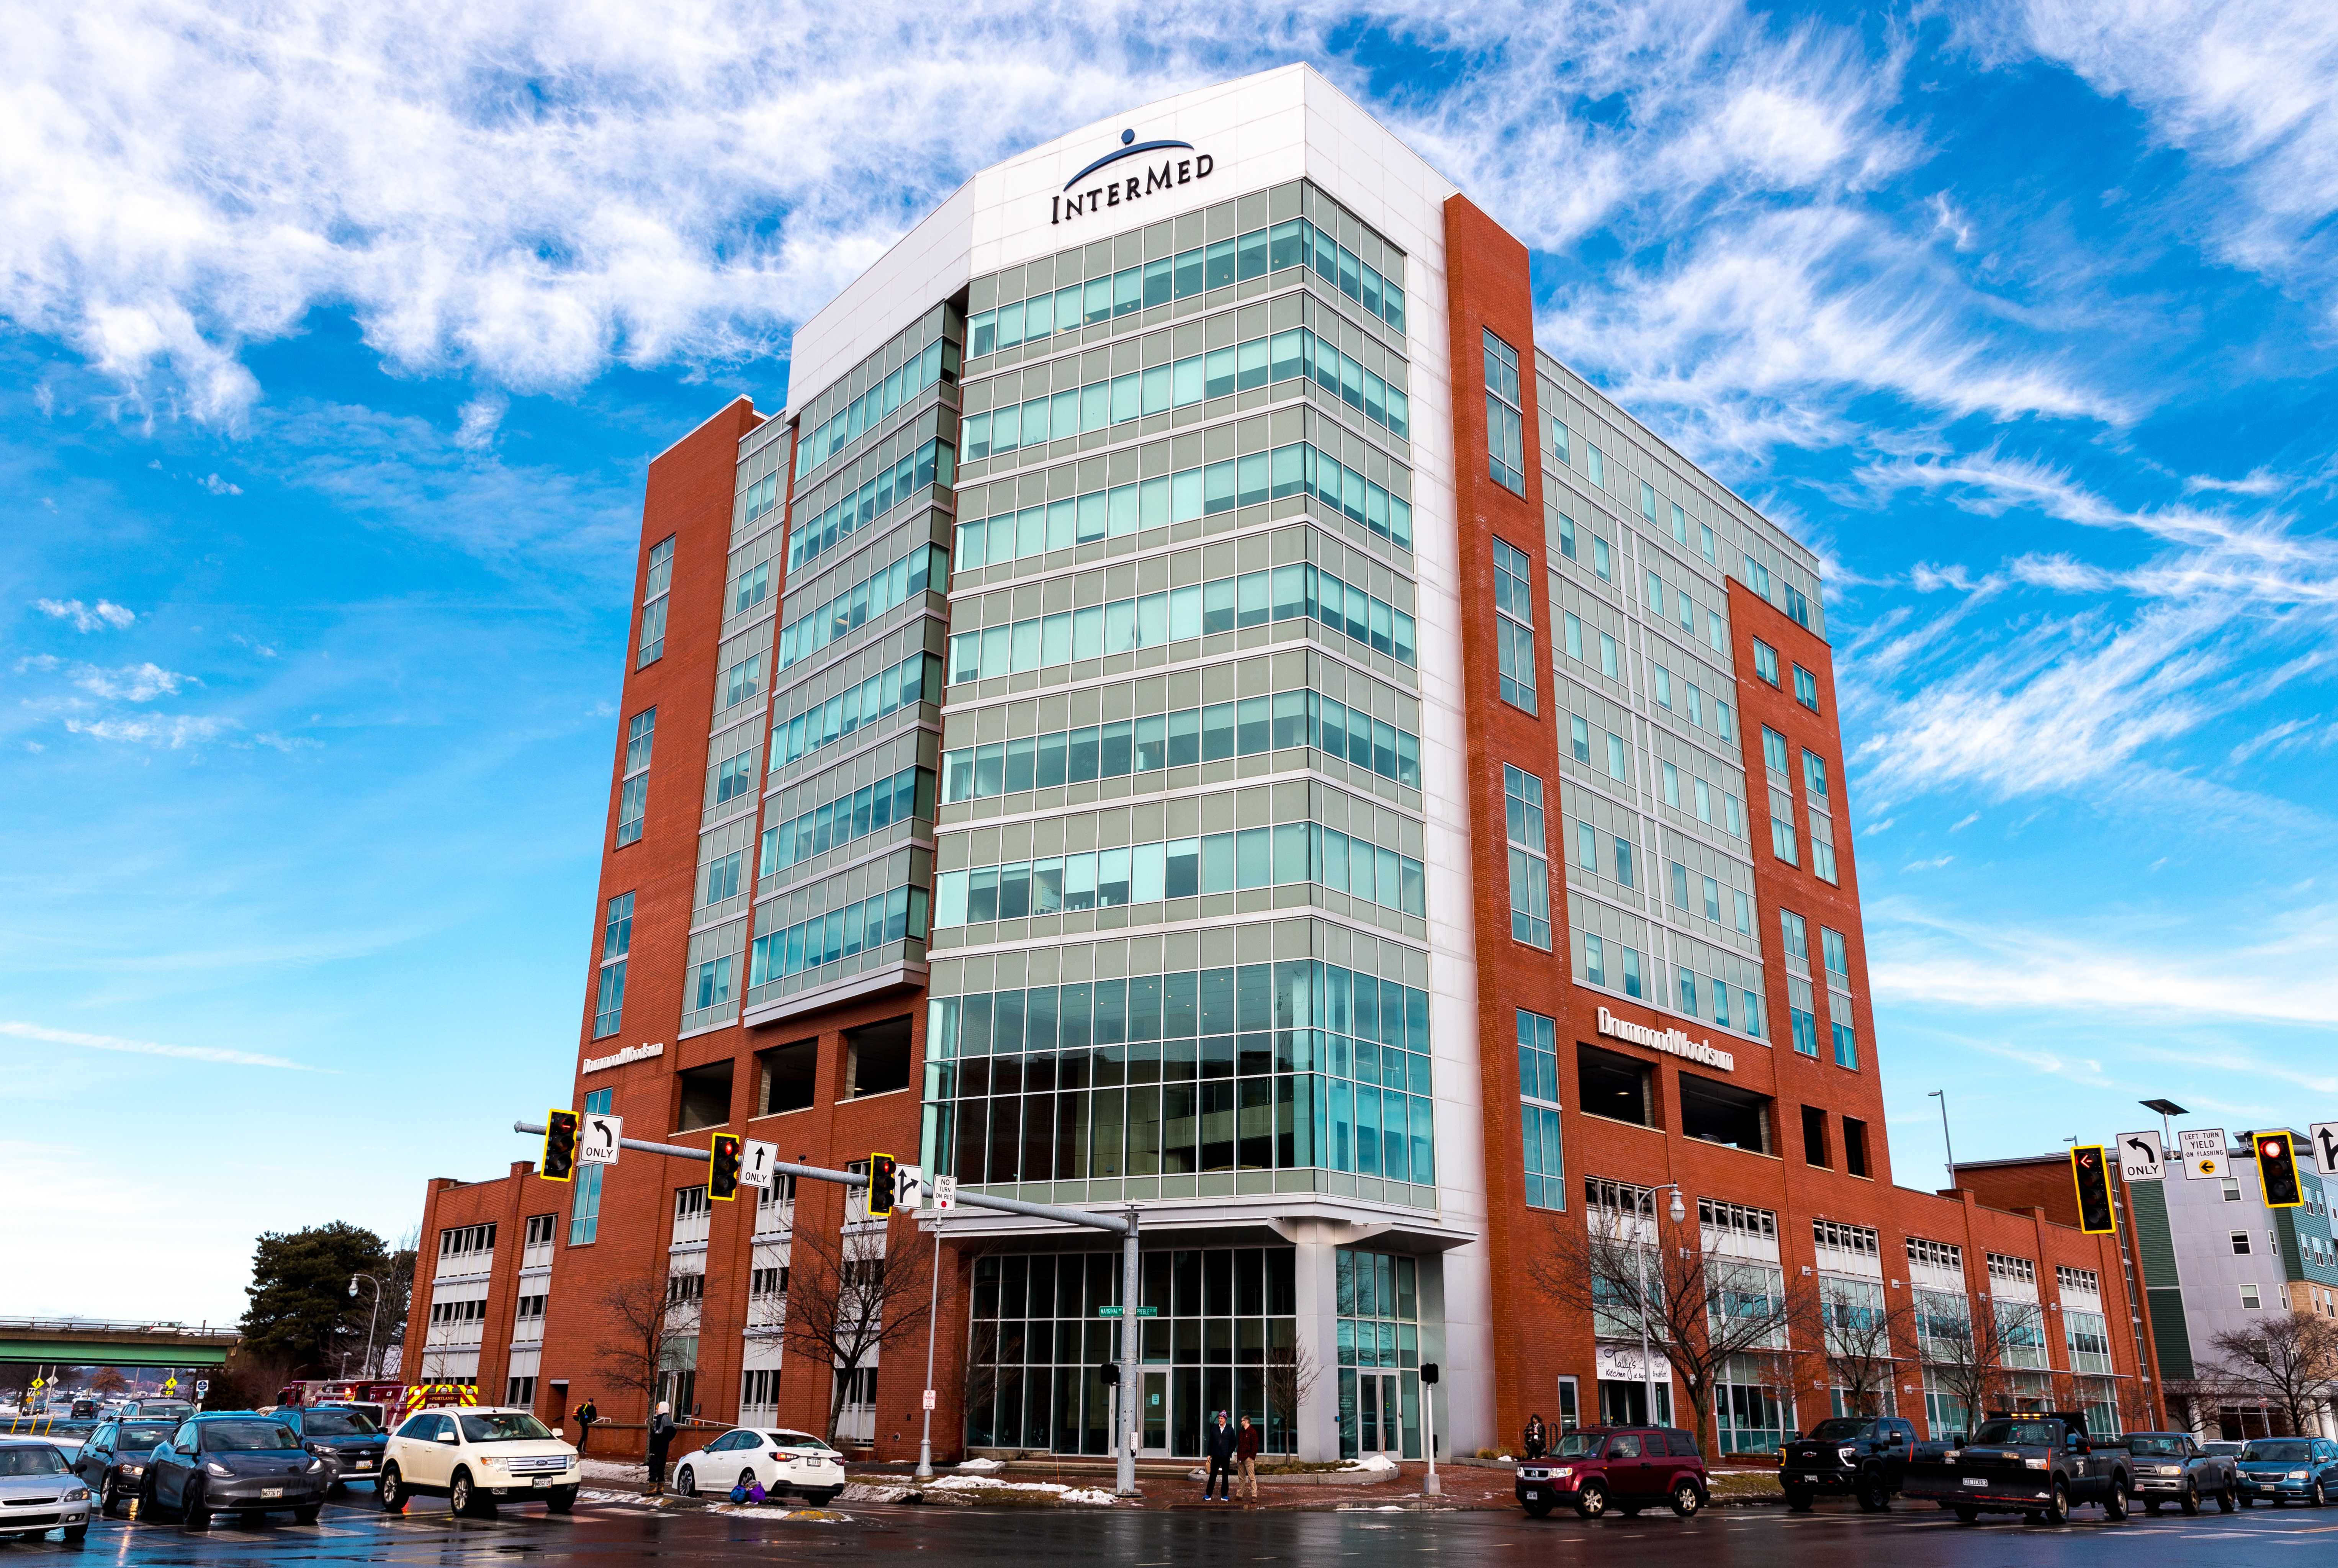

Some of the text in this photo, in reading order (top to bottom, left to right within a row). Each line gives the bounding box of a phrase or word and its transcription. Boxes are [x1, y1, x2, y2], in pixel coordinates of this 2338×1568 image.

[1598, 1006, 1734, 1071] DrummondWoodsum
[2191, 1140, 2214, 1149] YIELD
[586, 1147, 613, 1158] ONLY
[2127, 1164, 2159, 1176] ONLY
[745, 1172, 767, 1183] ONLY
[1606, 1369, 1626, 1378] Kitchen
